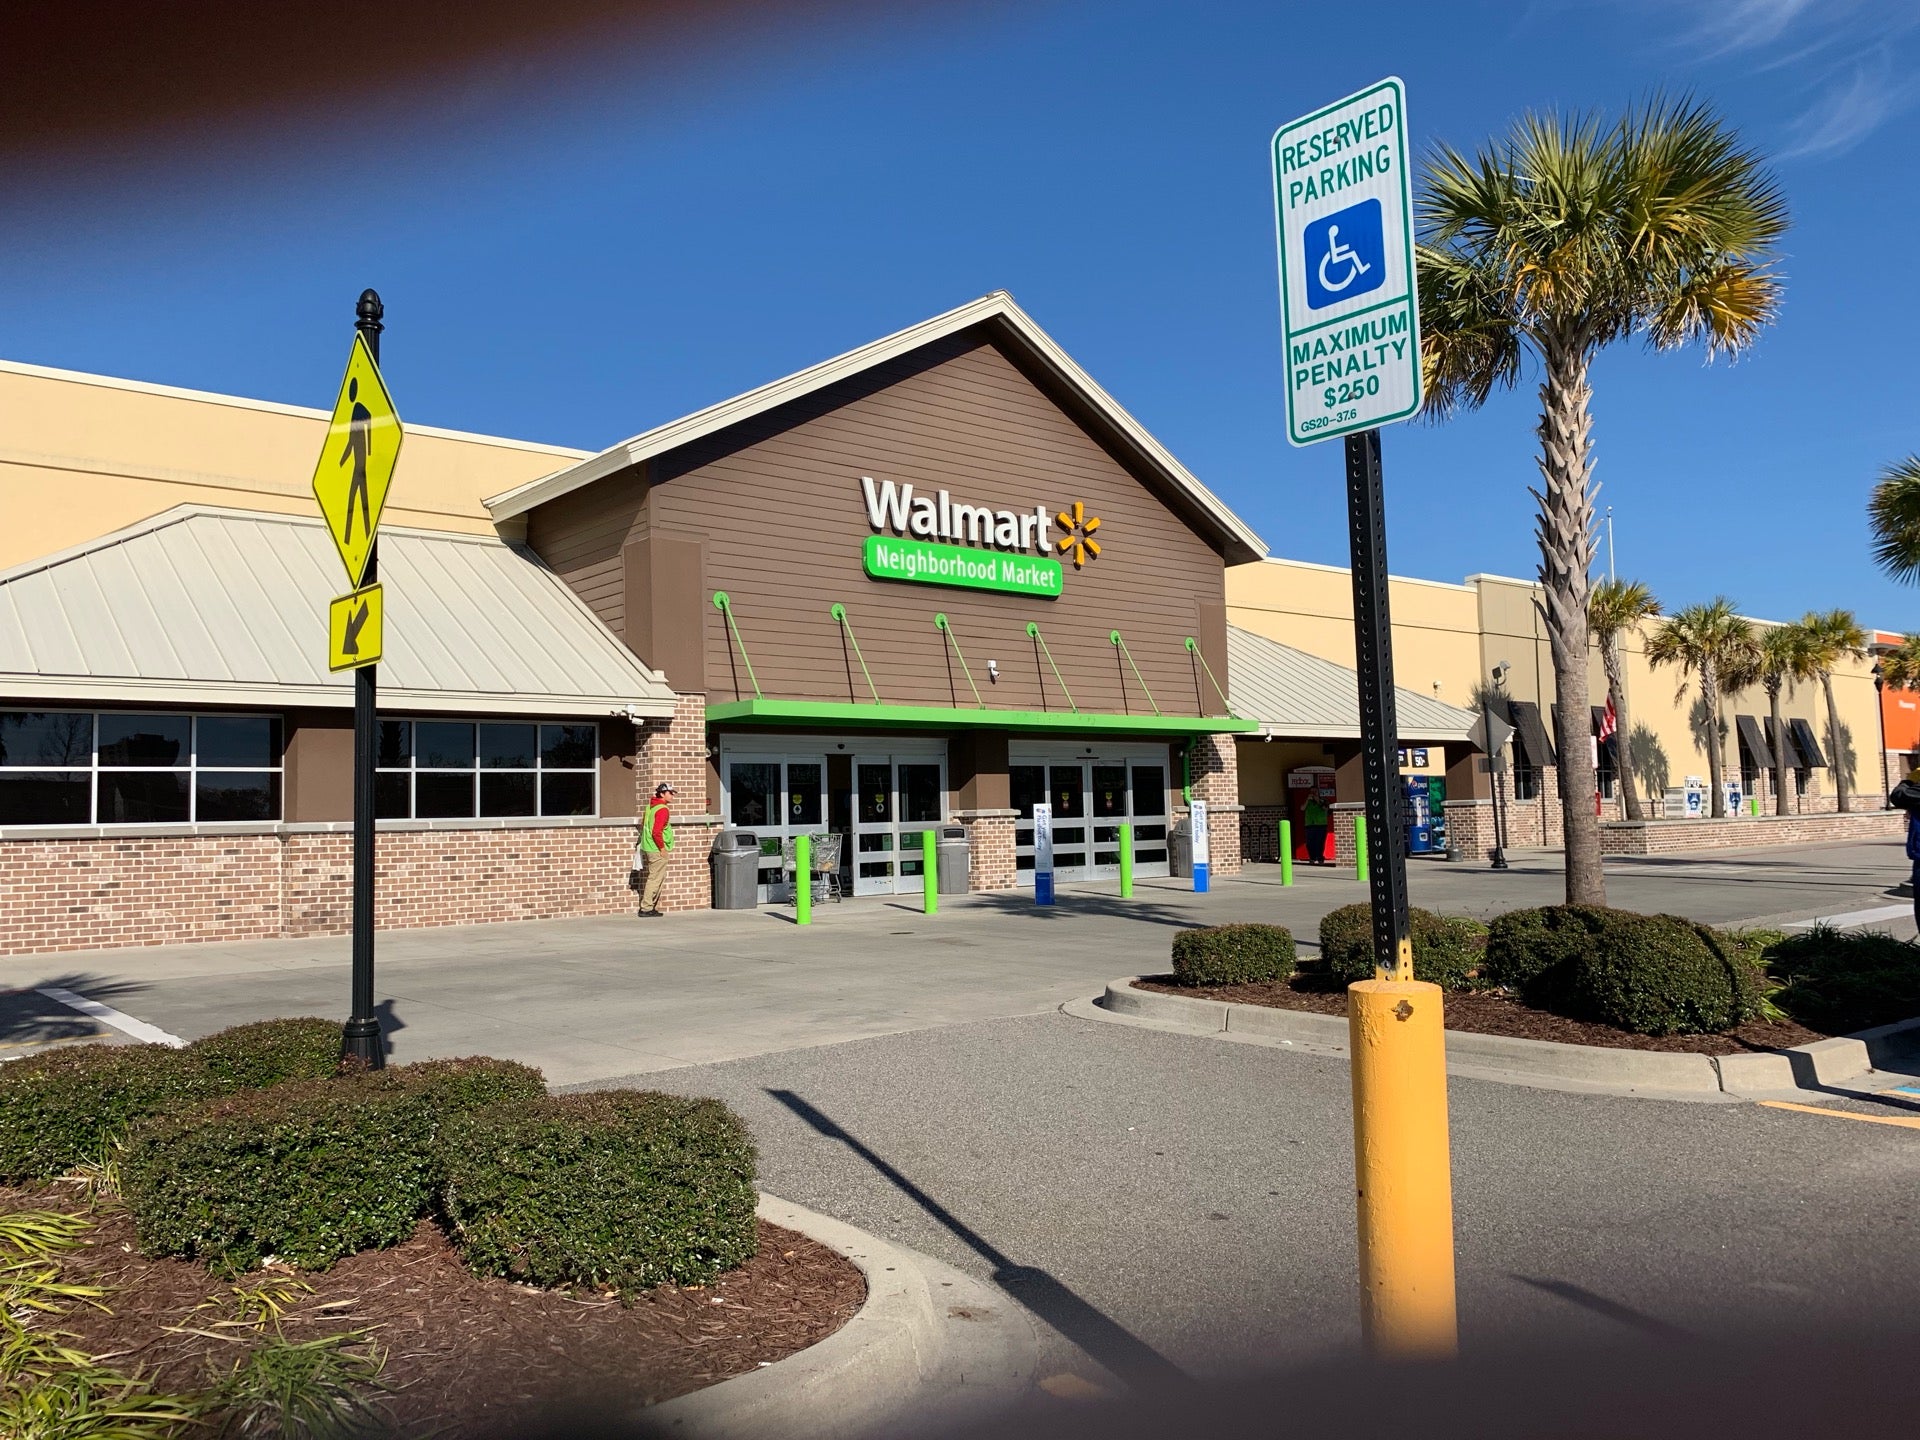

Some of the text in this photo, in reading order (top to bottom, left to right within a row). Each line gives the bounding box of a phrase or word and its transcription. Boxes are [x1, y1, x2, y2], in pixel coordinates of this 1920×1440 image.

[1283, 103, 1394, 174] RESERVED
[1290, 144, 1390, 209] PARKING
[1293, 310, 1407, 366] MAXIMUM
[1296, 338, 1407, 390] PENALTY
[1324, 374, 1380, 409] $250
[1301, 408, 1357, 432] GS20-37.6
[862, 476, 1053, 552] Walmart
[876, 544, 1056, 588] Neighborhood Market
